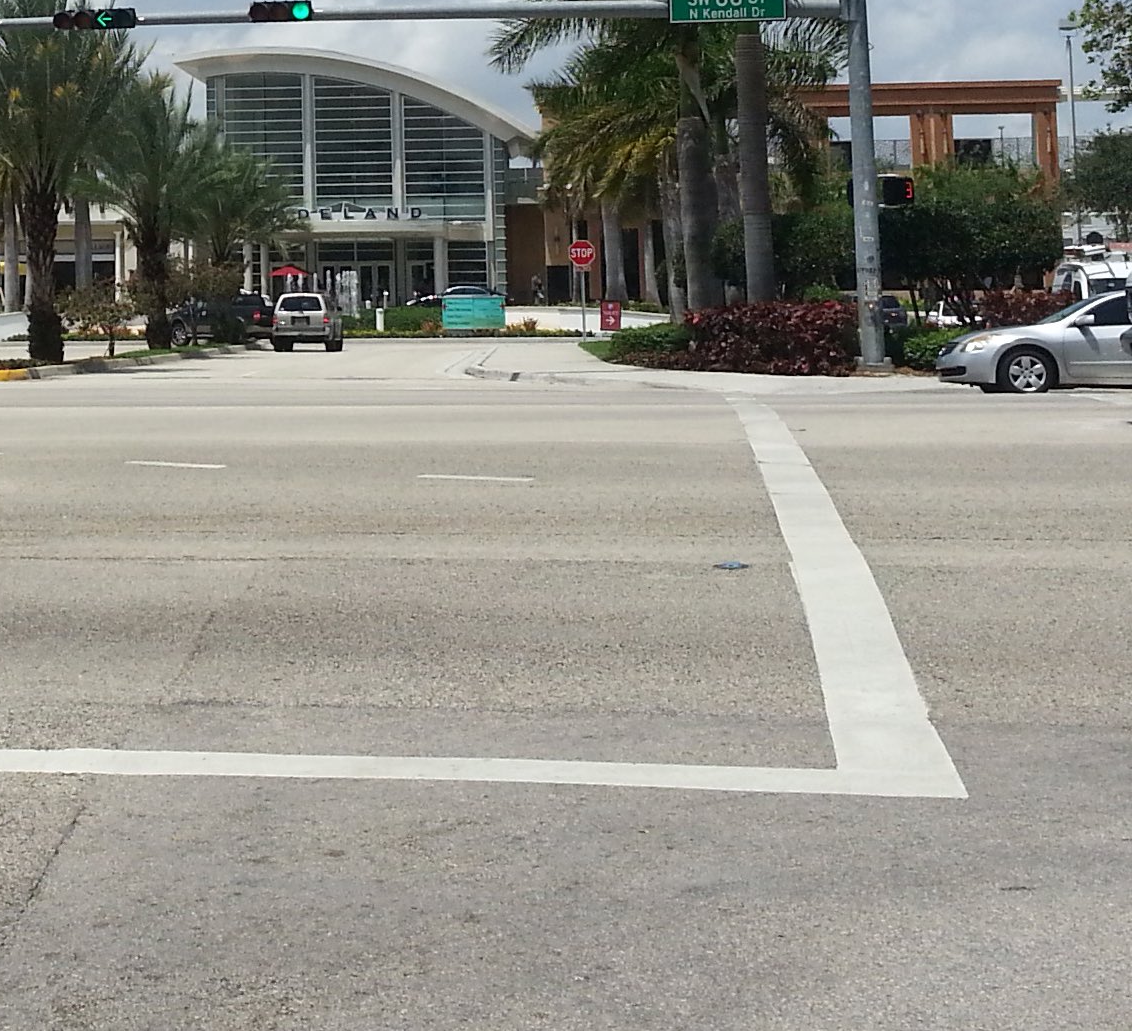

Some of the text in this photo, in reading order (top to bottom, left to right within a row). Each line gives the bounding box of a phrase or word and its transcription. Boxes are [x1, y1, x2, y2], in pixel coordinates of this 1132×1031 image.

[689, 6, 766, 19] N Kendall Dr
[297, 206, 423, 221] DELAND
[570, 247, 594, 259] STOP
